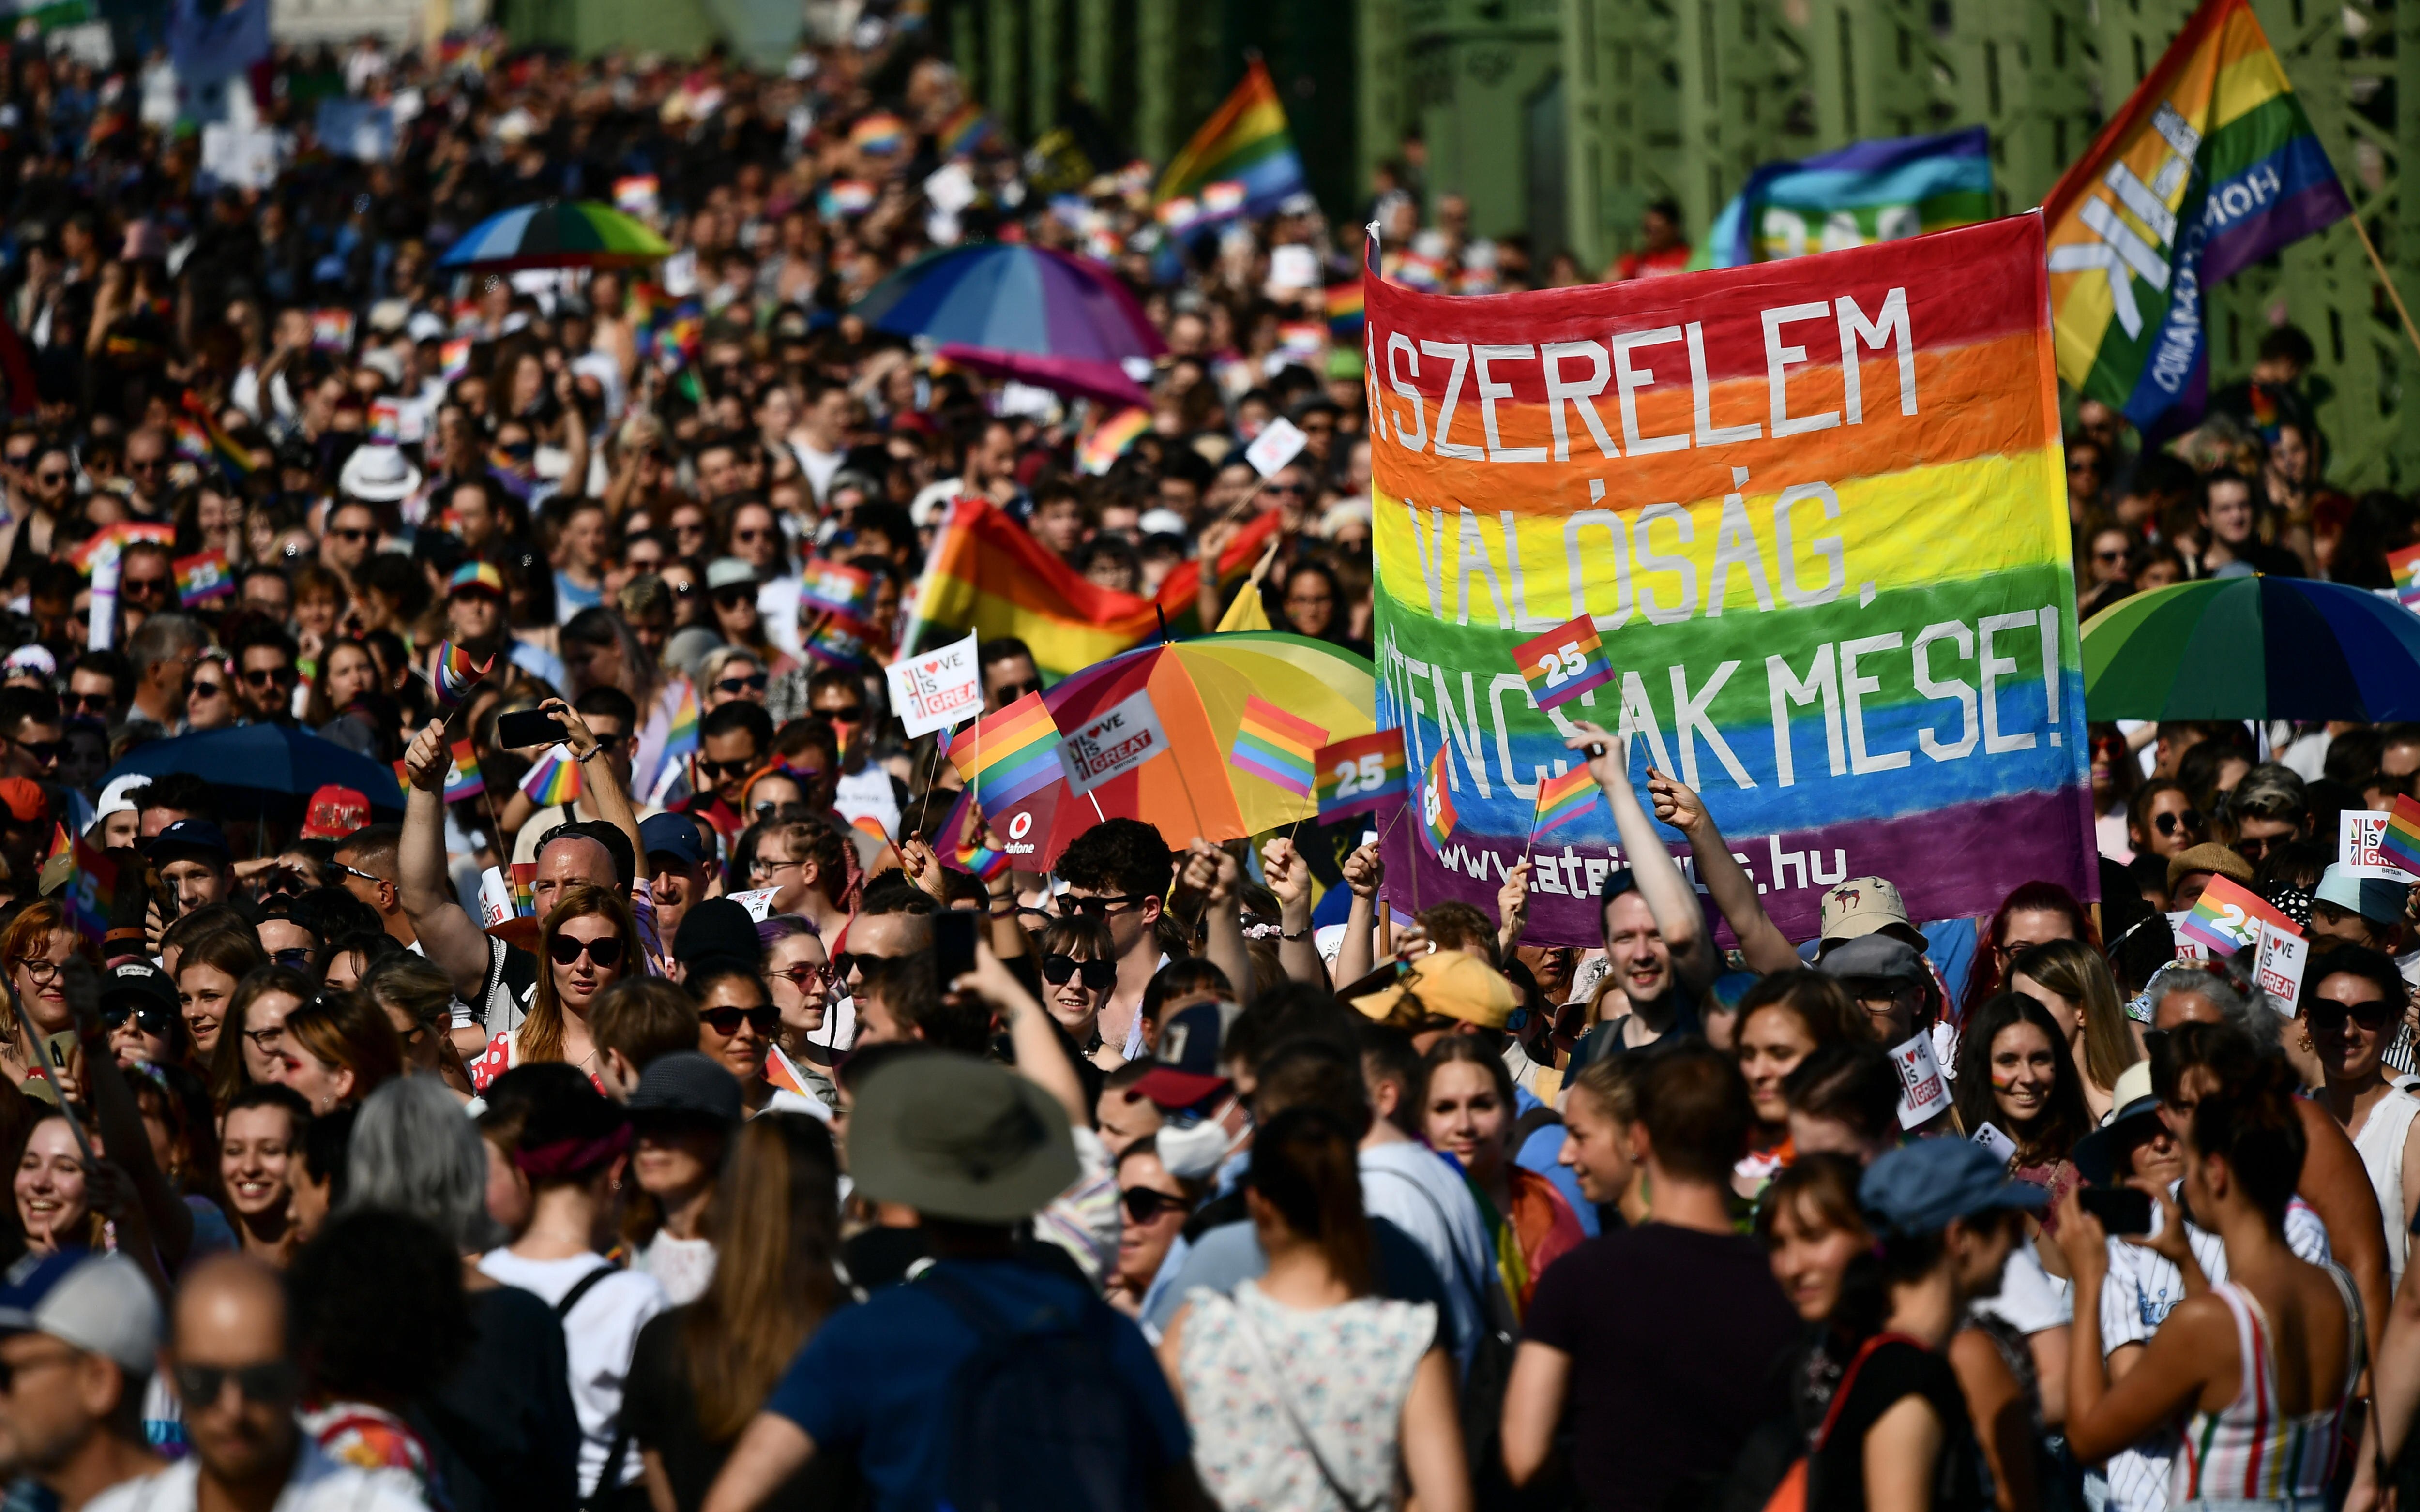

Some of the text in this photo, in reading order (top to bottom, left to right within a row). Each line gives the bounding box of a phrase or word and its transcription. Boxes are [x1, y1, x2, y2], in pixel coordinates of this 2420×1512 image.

[1387, 287, 1918, 463] SZERELEM
[1405, 467, 1876, 632] VALÓSÁG,
[188, 559, 219, 593] 25
[1538, 641, 1587, 689] 25
[921, 679, 937, 694] IS
[1765, 604, 2062, 788] MESE!
[1084, 742, 1101, 758] IS
[1093, 731, 1150, 771] GREAT
[1334, 752, 1386, 800] 25
[1424, 775, 1442, 826] 25
[1004, 841, 1035, 854] dafone
[2364, 833, 2378, 847] IS
[2382, 868, 2402, 876] BRITAIN
[2209, 904, 2262, 946] 25
[2264, 952, 2273, 967] IS
[2261, 970, 2295, 1001] GREAT
[1906, 1068, 1919, 1086] IS
